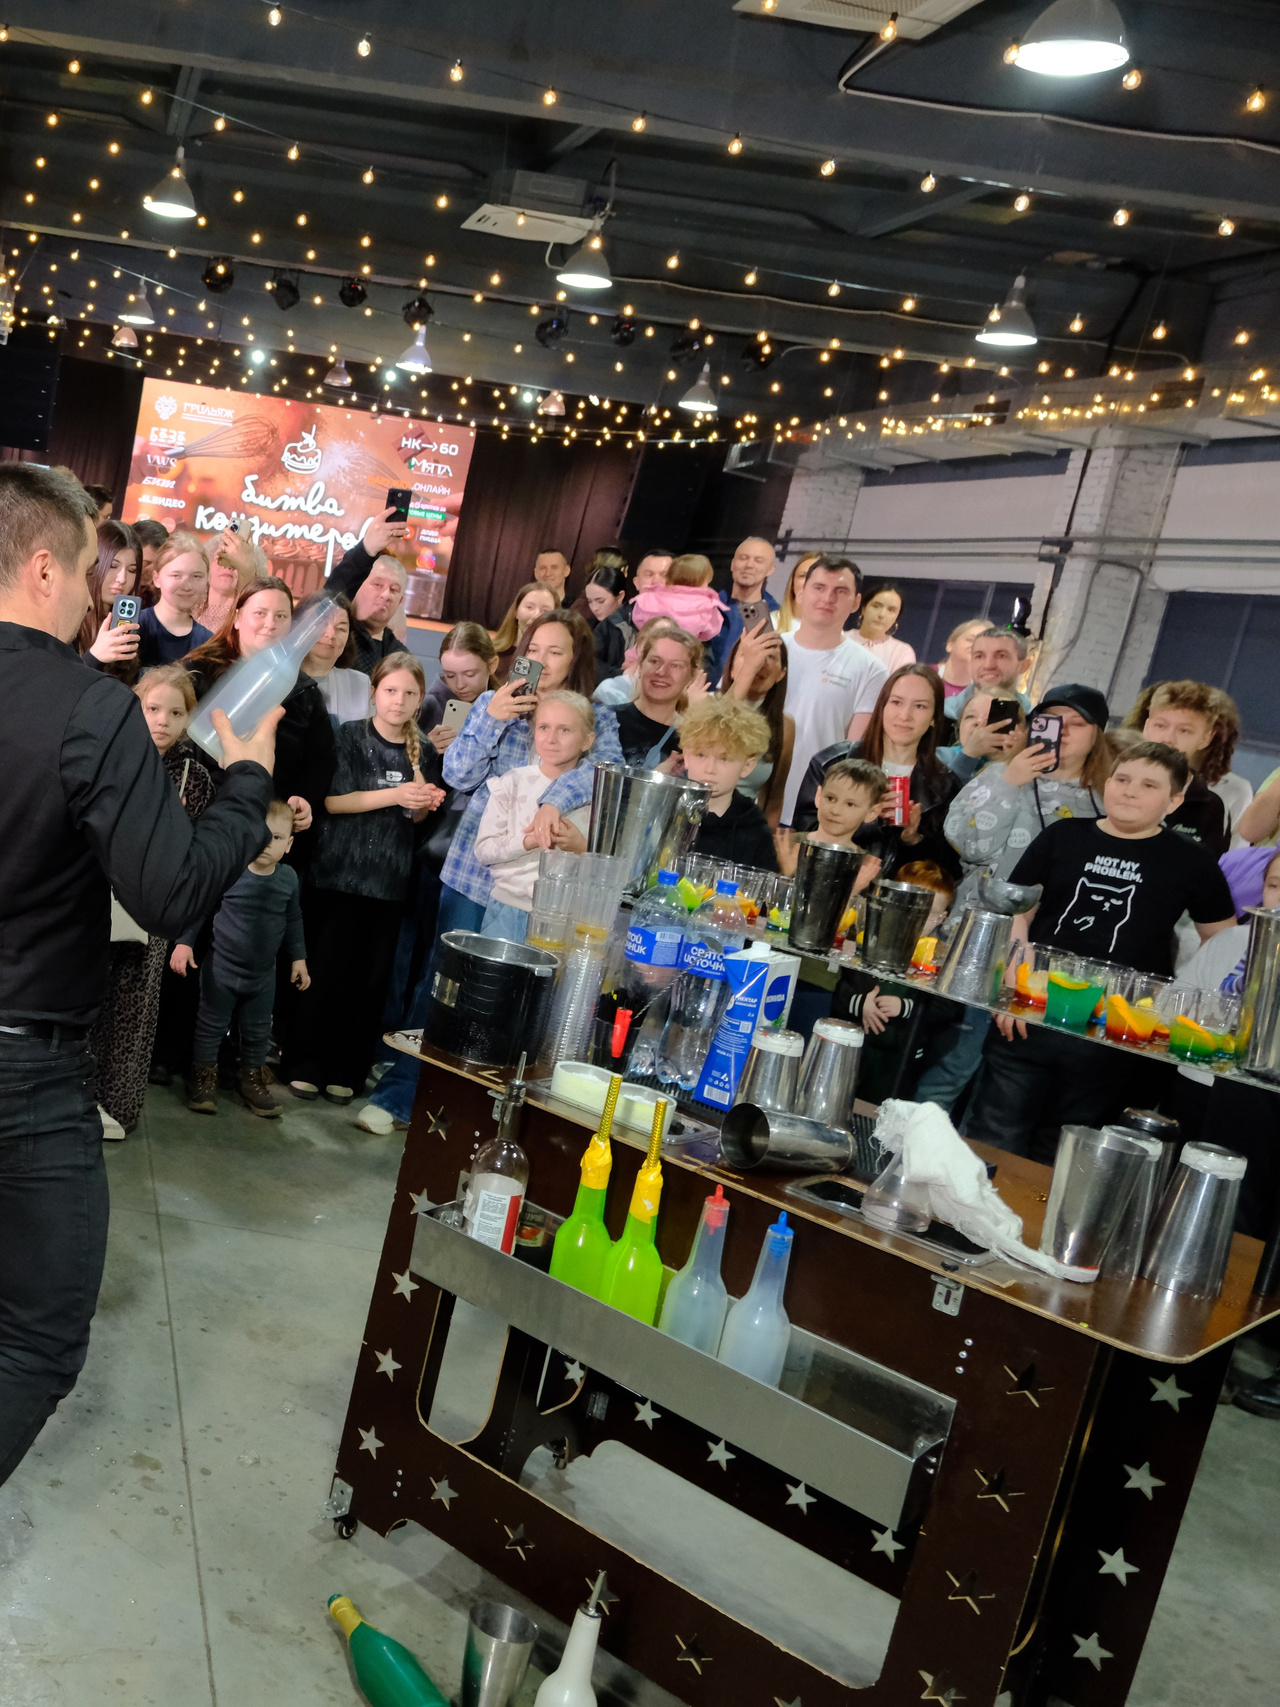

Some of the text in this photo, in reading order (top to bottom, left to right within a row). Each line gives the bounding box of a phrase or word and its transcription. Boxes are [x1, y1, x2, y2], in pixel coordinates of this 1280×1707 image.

[183, 402, 235, 419] ГРИЛЬЯЖ
[439, 443, 459, 456] 60
[1094, 855, 1140, 872] NOT MY
[1084, 862, 1143, 883] PROBLEM.
[690, 946, 725, 963] СВЯТО
